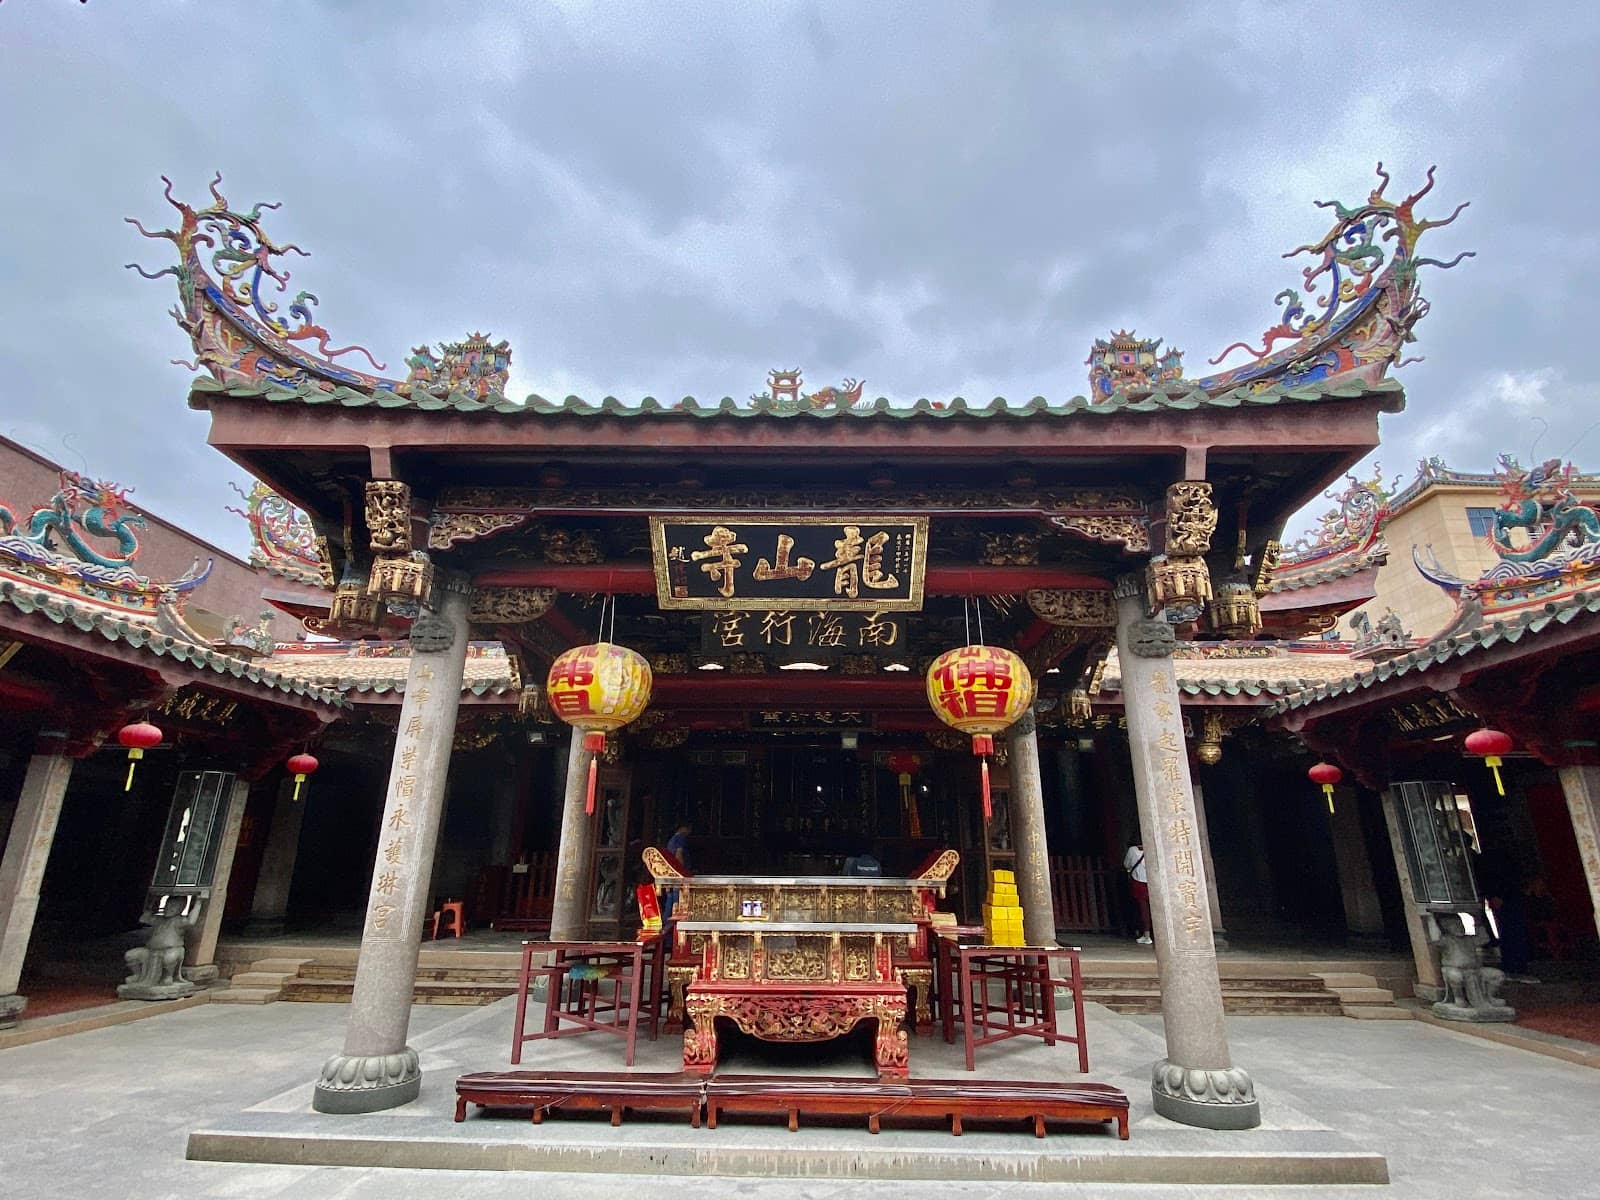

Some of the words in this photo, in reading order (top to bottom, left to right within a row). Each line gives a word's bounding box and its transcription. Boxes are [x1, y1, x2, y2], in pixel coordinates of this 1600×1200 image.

[691, 526, 899, 598] 龍山寺
[712, 611, 898, 647] 南海行宮
[934, 660, 1013, 718] 佛祖
